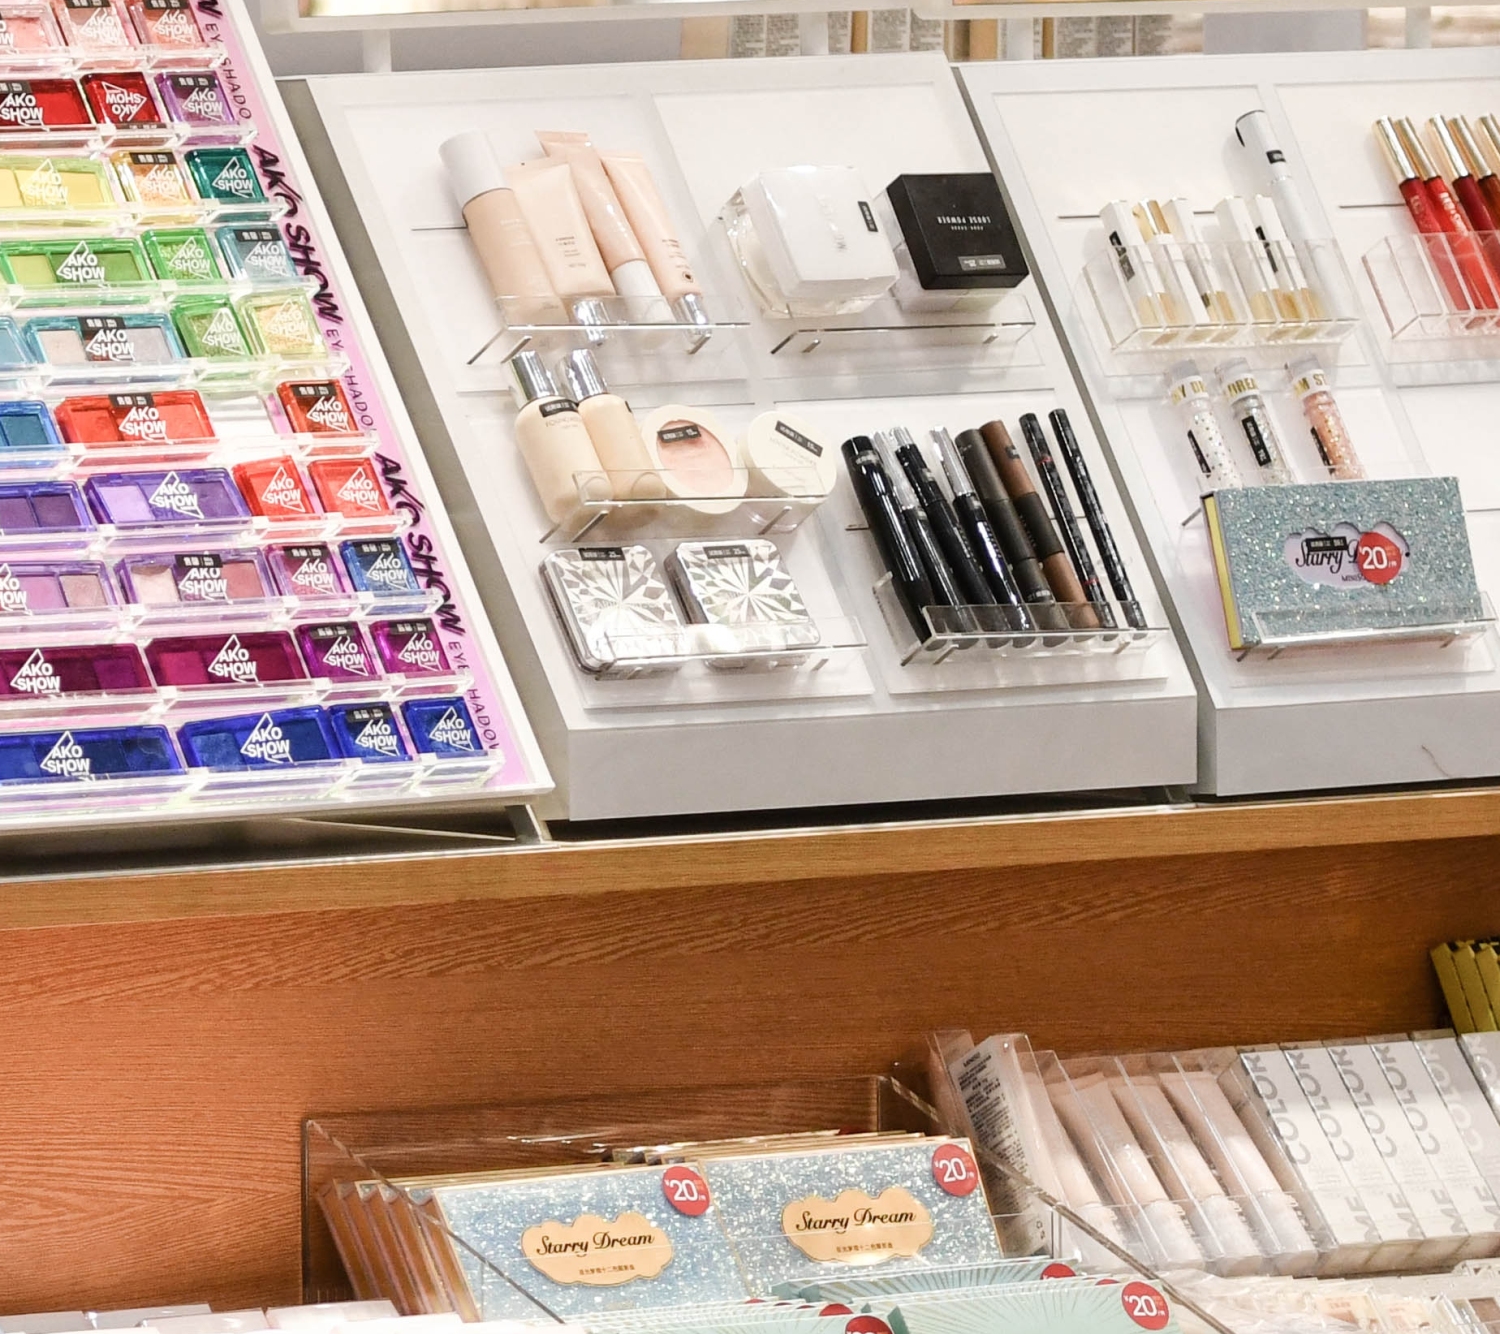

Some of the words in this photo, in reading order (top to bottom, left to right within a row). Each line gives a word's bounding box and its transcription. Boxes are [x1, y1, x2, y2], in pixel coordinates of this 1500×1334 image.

[5, 93, 37, 108] AKO
[1, 106, 44, 121] SHOW
[220, 167, 248, 180] AKO
[216, 178, 253, 192] SHOW
[67, 253, 99, 268] AKO
[62, 266, 106, 281] SHOW
[159, 482, 190, 497] AKO
[346, 477, 372, 491] AKO
[155, 495, 198, 510] SHOW
[342, 489, 379, 503] SHOW
[219, 649, 250, 663] AKO
[22, 662, 54, 677] AKO
[214, 661, 257, 676] SHOW
[17, 676, 62, 692] SHOW
[438, 718, 464, 730] AKO
[251, 727, 283, 742] AKO
[434, 728, 471, 743] SHOW
[52, 745, 84, 759] AKO
[247, 740, 291, 756] SHOW
[46, 758, 91, 774] SHOW
[796, 1209, 850, 1235] Starry
[854, 1207, 917, 1227] Dream
[536, 1234, 589, 1258] Starry
[594, 1230, 656, 1252] Dream
